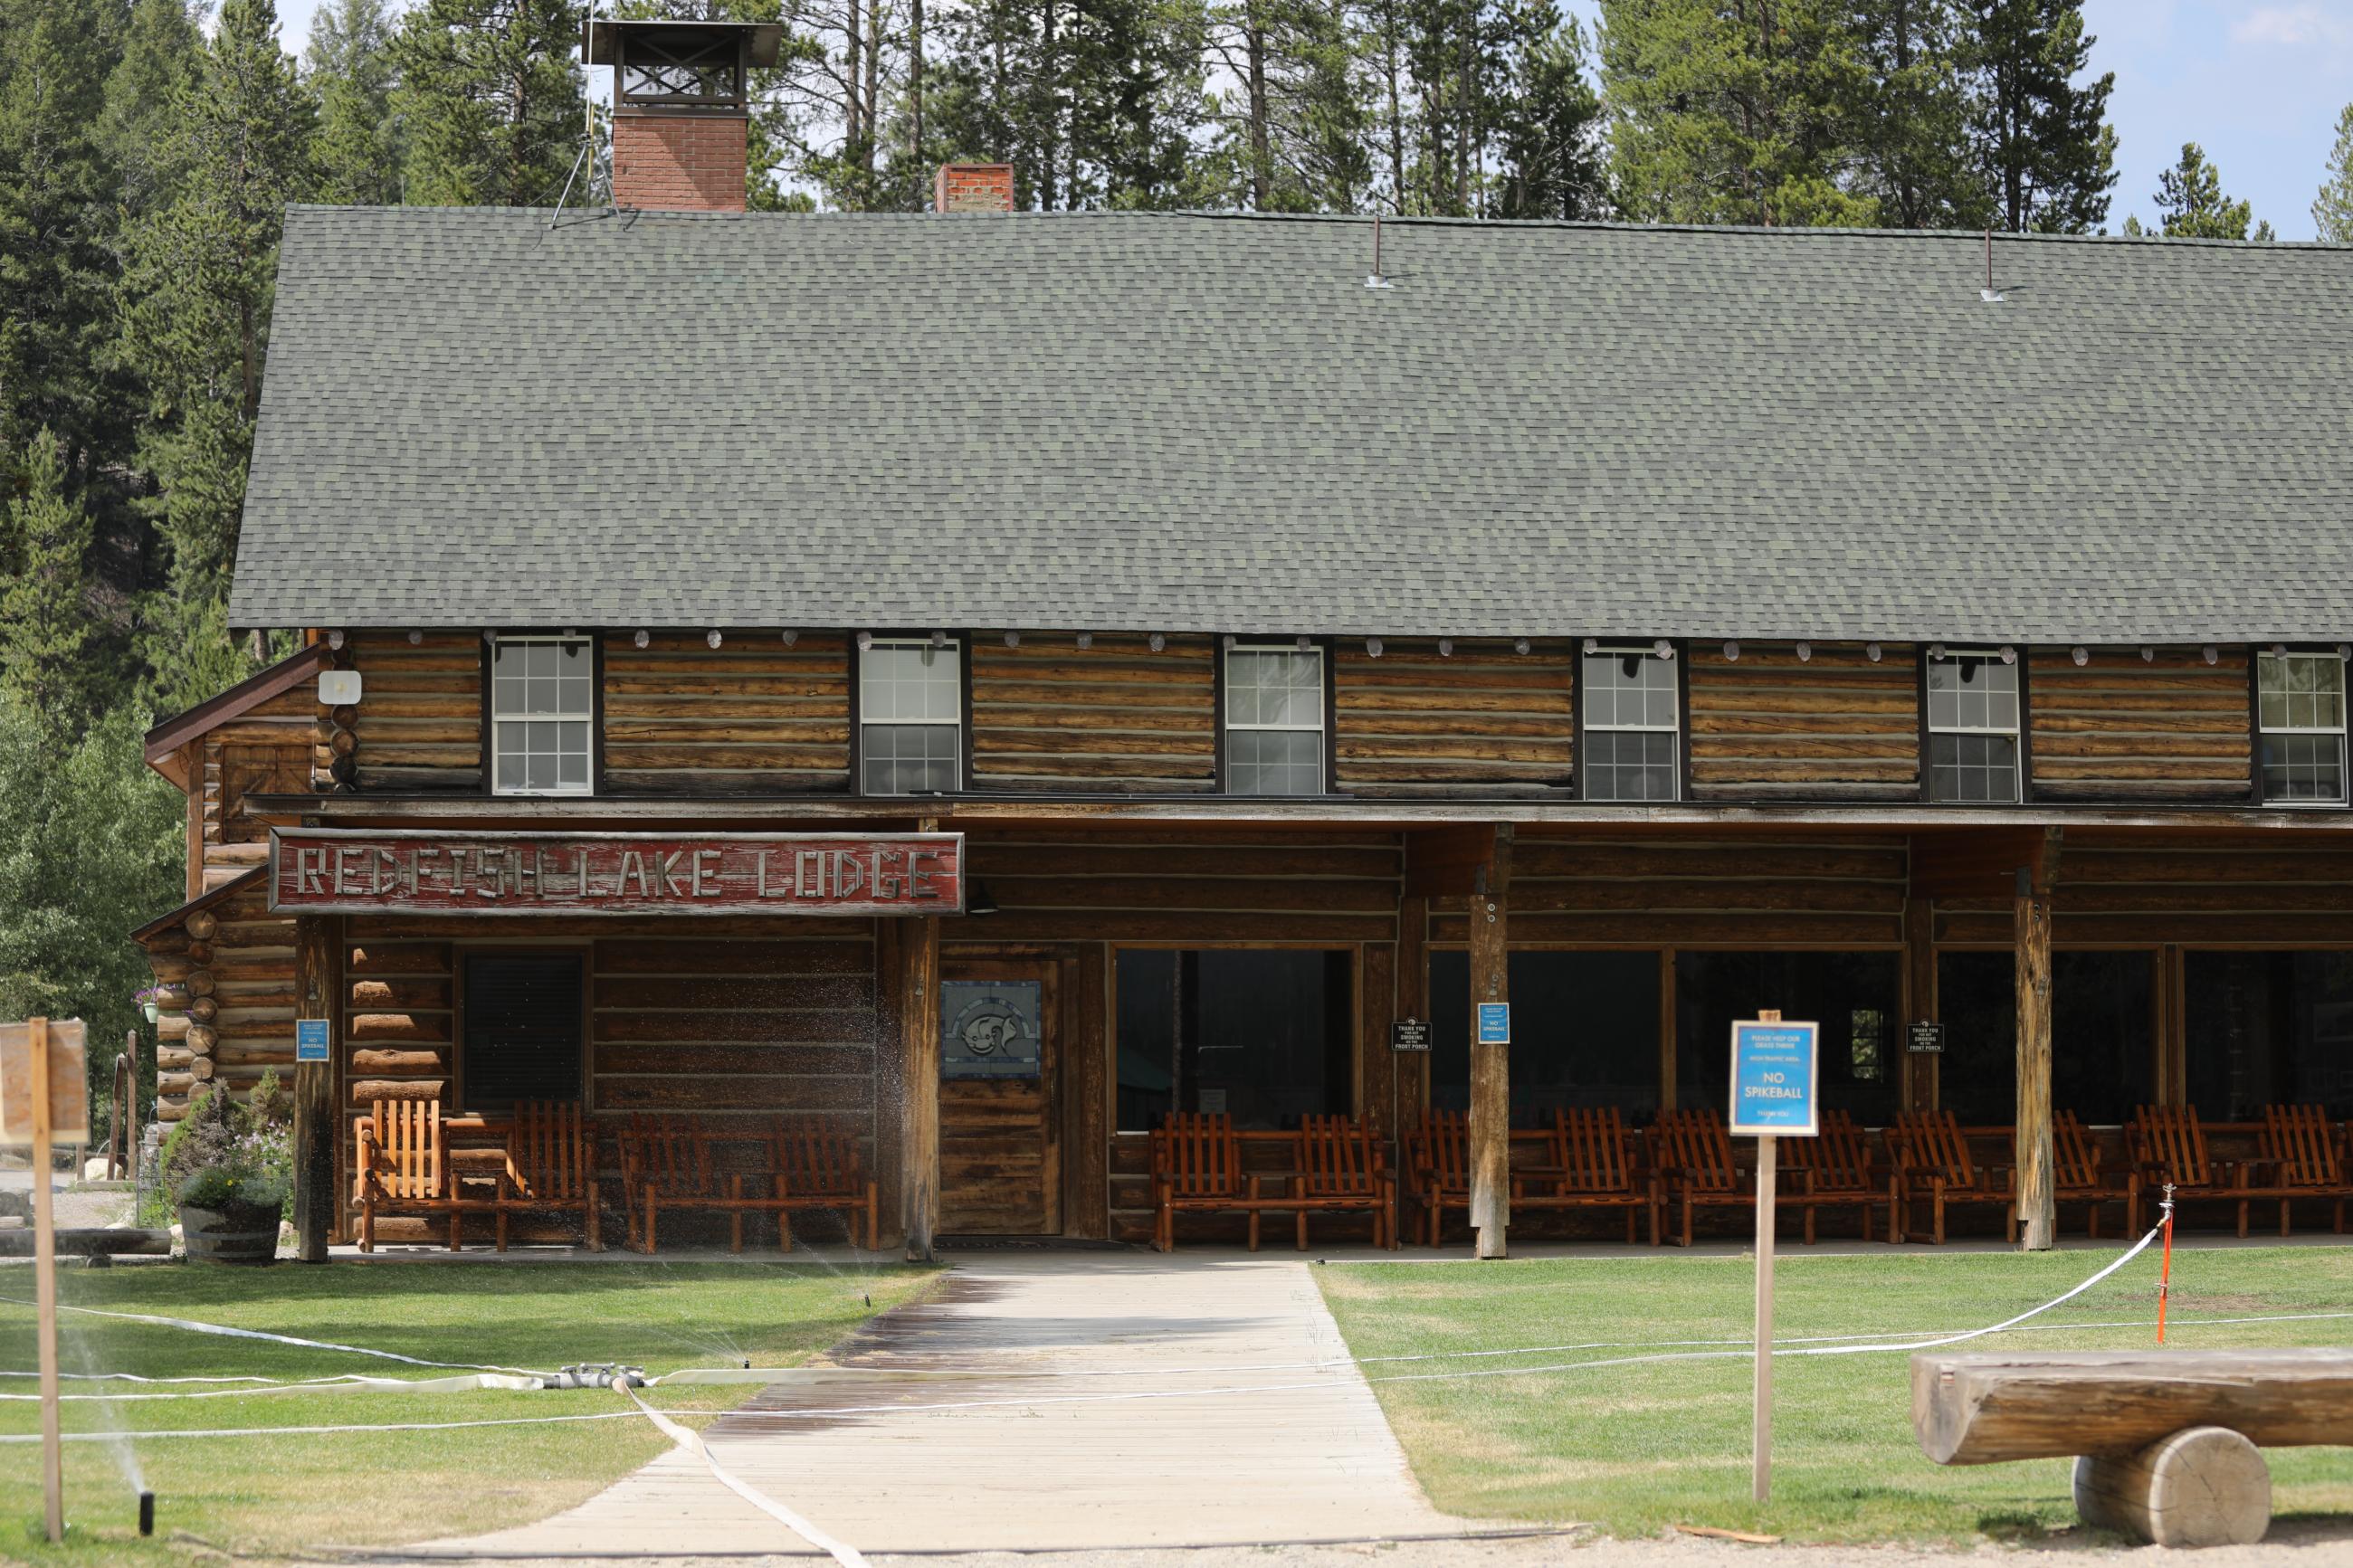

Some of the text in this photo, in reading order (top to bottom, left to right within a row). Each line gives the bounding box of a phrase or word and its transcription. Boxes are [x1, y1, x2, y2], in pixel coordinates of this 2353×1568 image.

[297, 848, 938, 898] REDFISH LAKE LODGE
[1763, 1072, 1785, 1084] NO
[1745, 1087, 1803, 1098] SPIKEBALL
